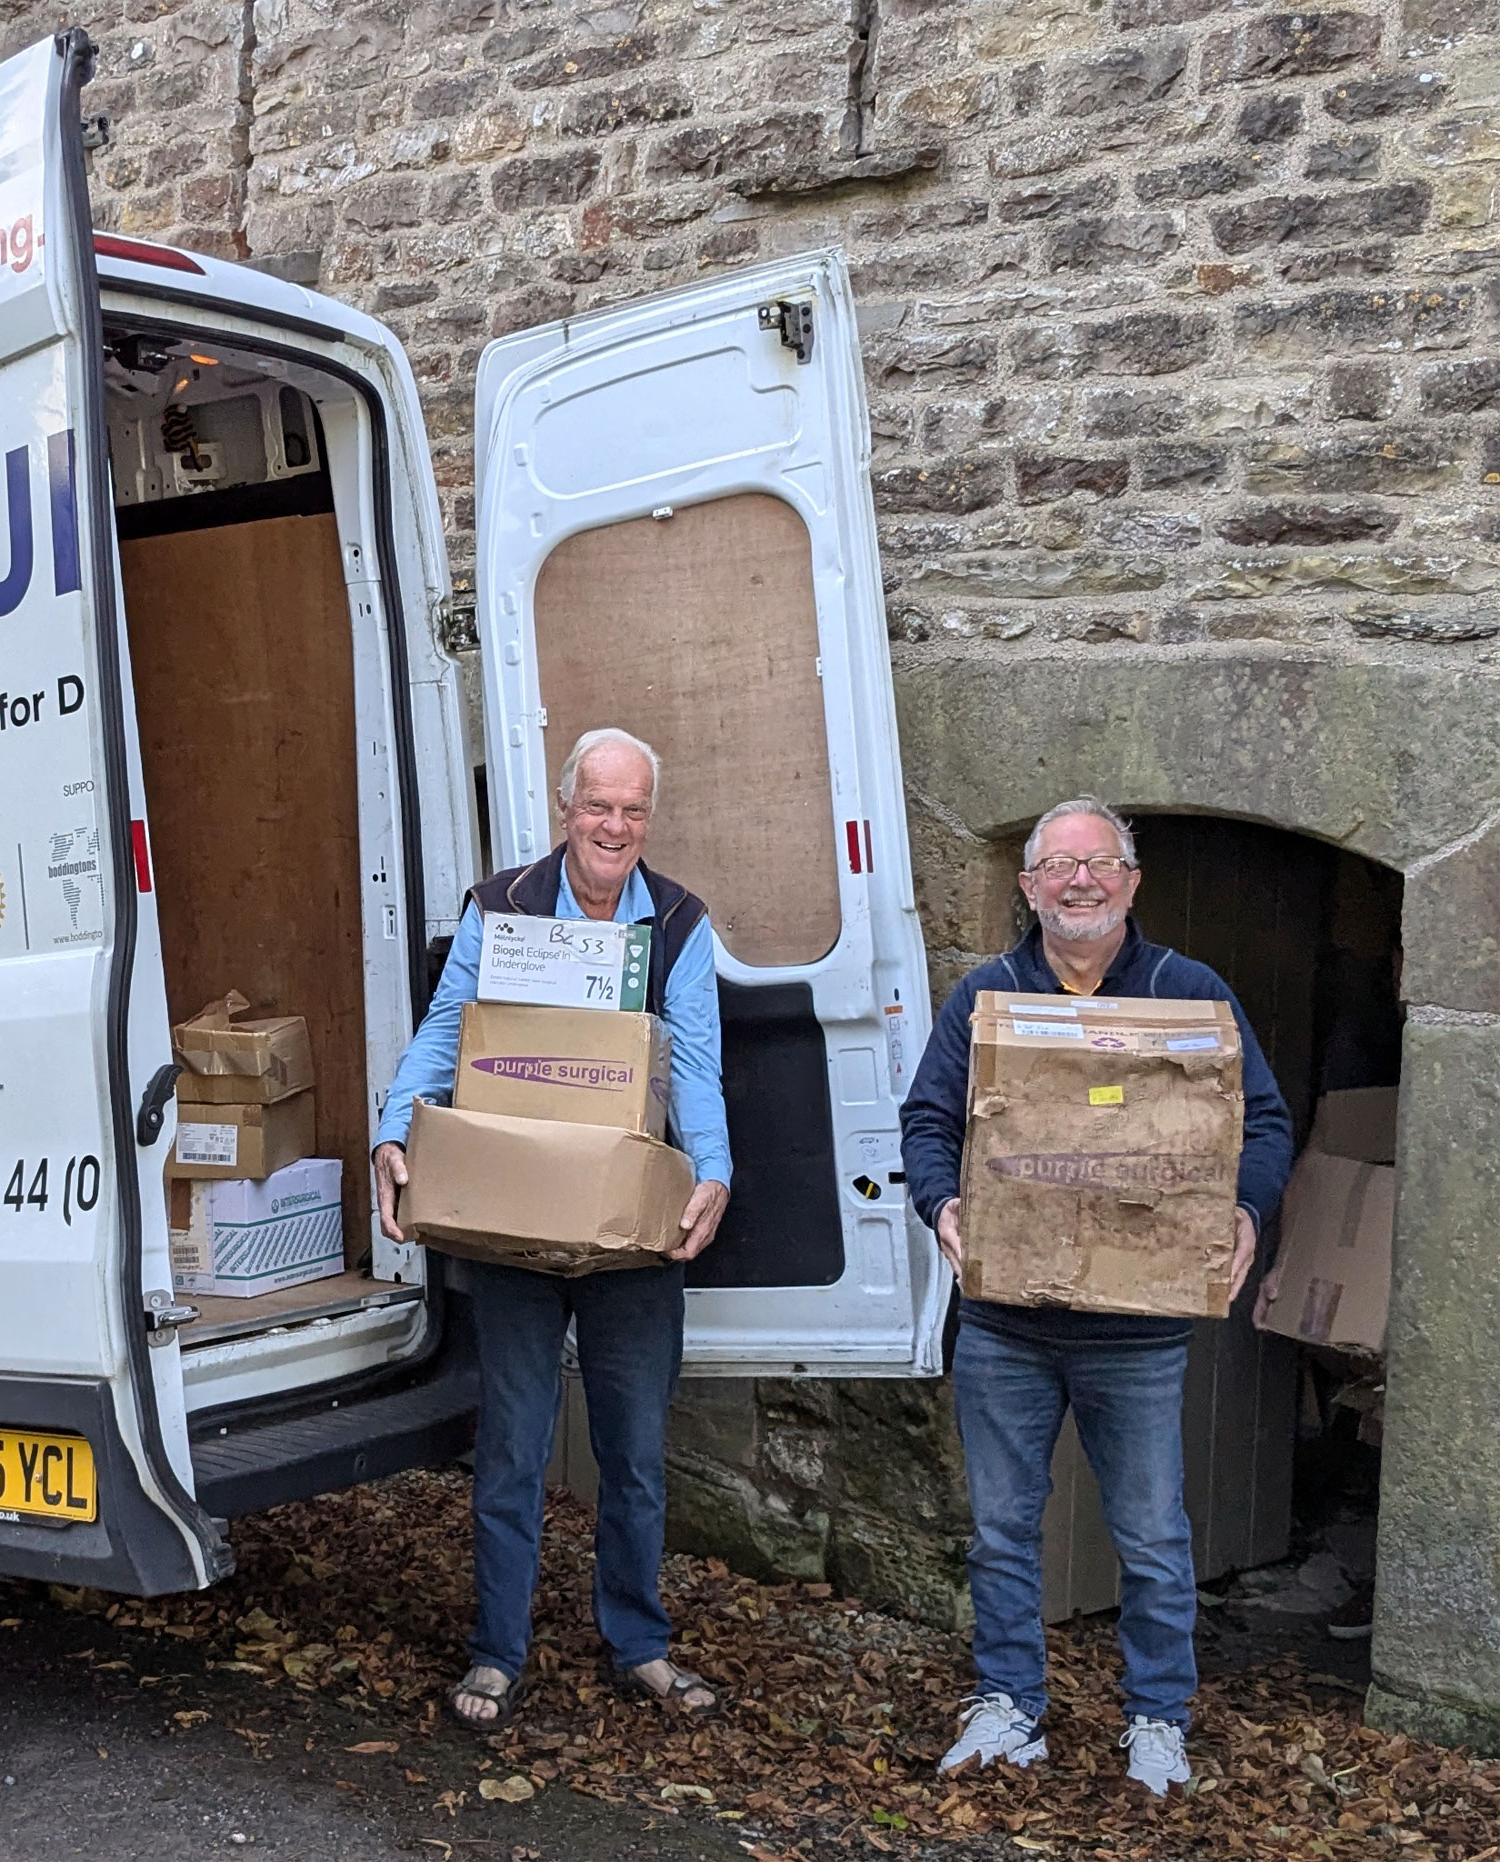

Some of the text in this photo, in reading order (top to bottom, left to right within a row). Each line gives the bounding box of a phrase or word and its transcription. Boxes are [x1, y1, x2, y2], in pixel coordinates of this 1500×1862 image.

[48, 859, 97, 879] boddingtons
[493, 944, 524, 958] Biogel
[491, 957, 546, 972] Underglove
[493, 1057, 633, 1084] purple surgical
[18, 1442, 88, 1510] YCL
